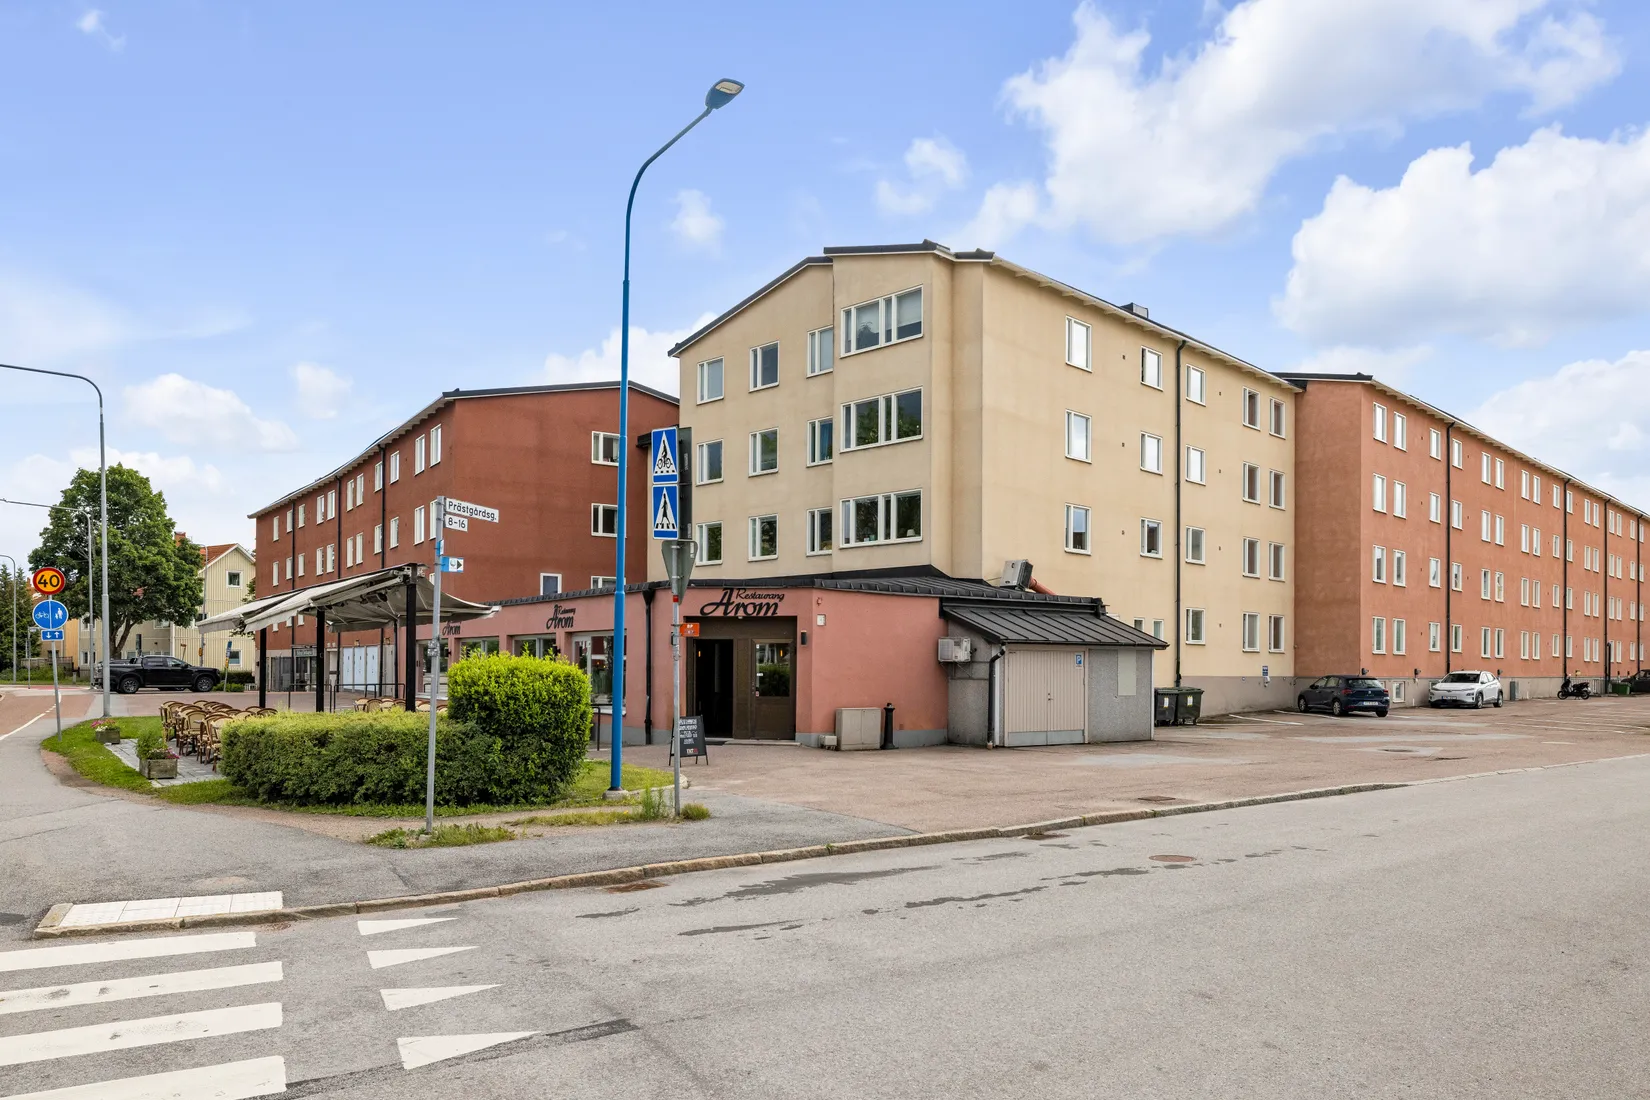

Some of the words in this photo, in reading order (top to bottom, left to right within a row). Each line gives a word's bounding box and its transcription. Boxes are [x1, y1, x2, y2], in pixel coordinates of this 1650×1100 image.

[448, 500, 497, 521] Prästgårdsg.
[447, 517, 466, 529] 8-16
[37, 574, 60, 588] 40
[699, 587, 779, 616] Arom
[735, 588, 785, 602] Restaurang
[546, 604, 574, 630] Arom
